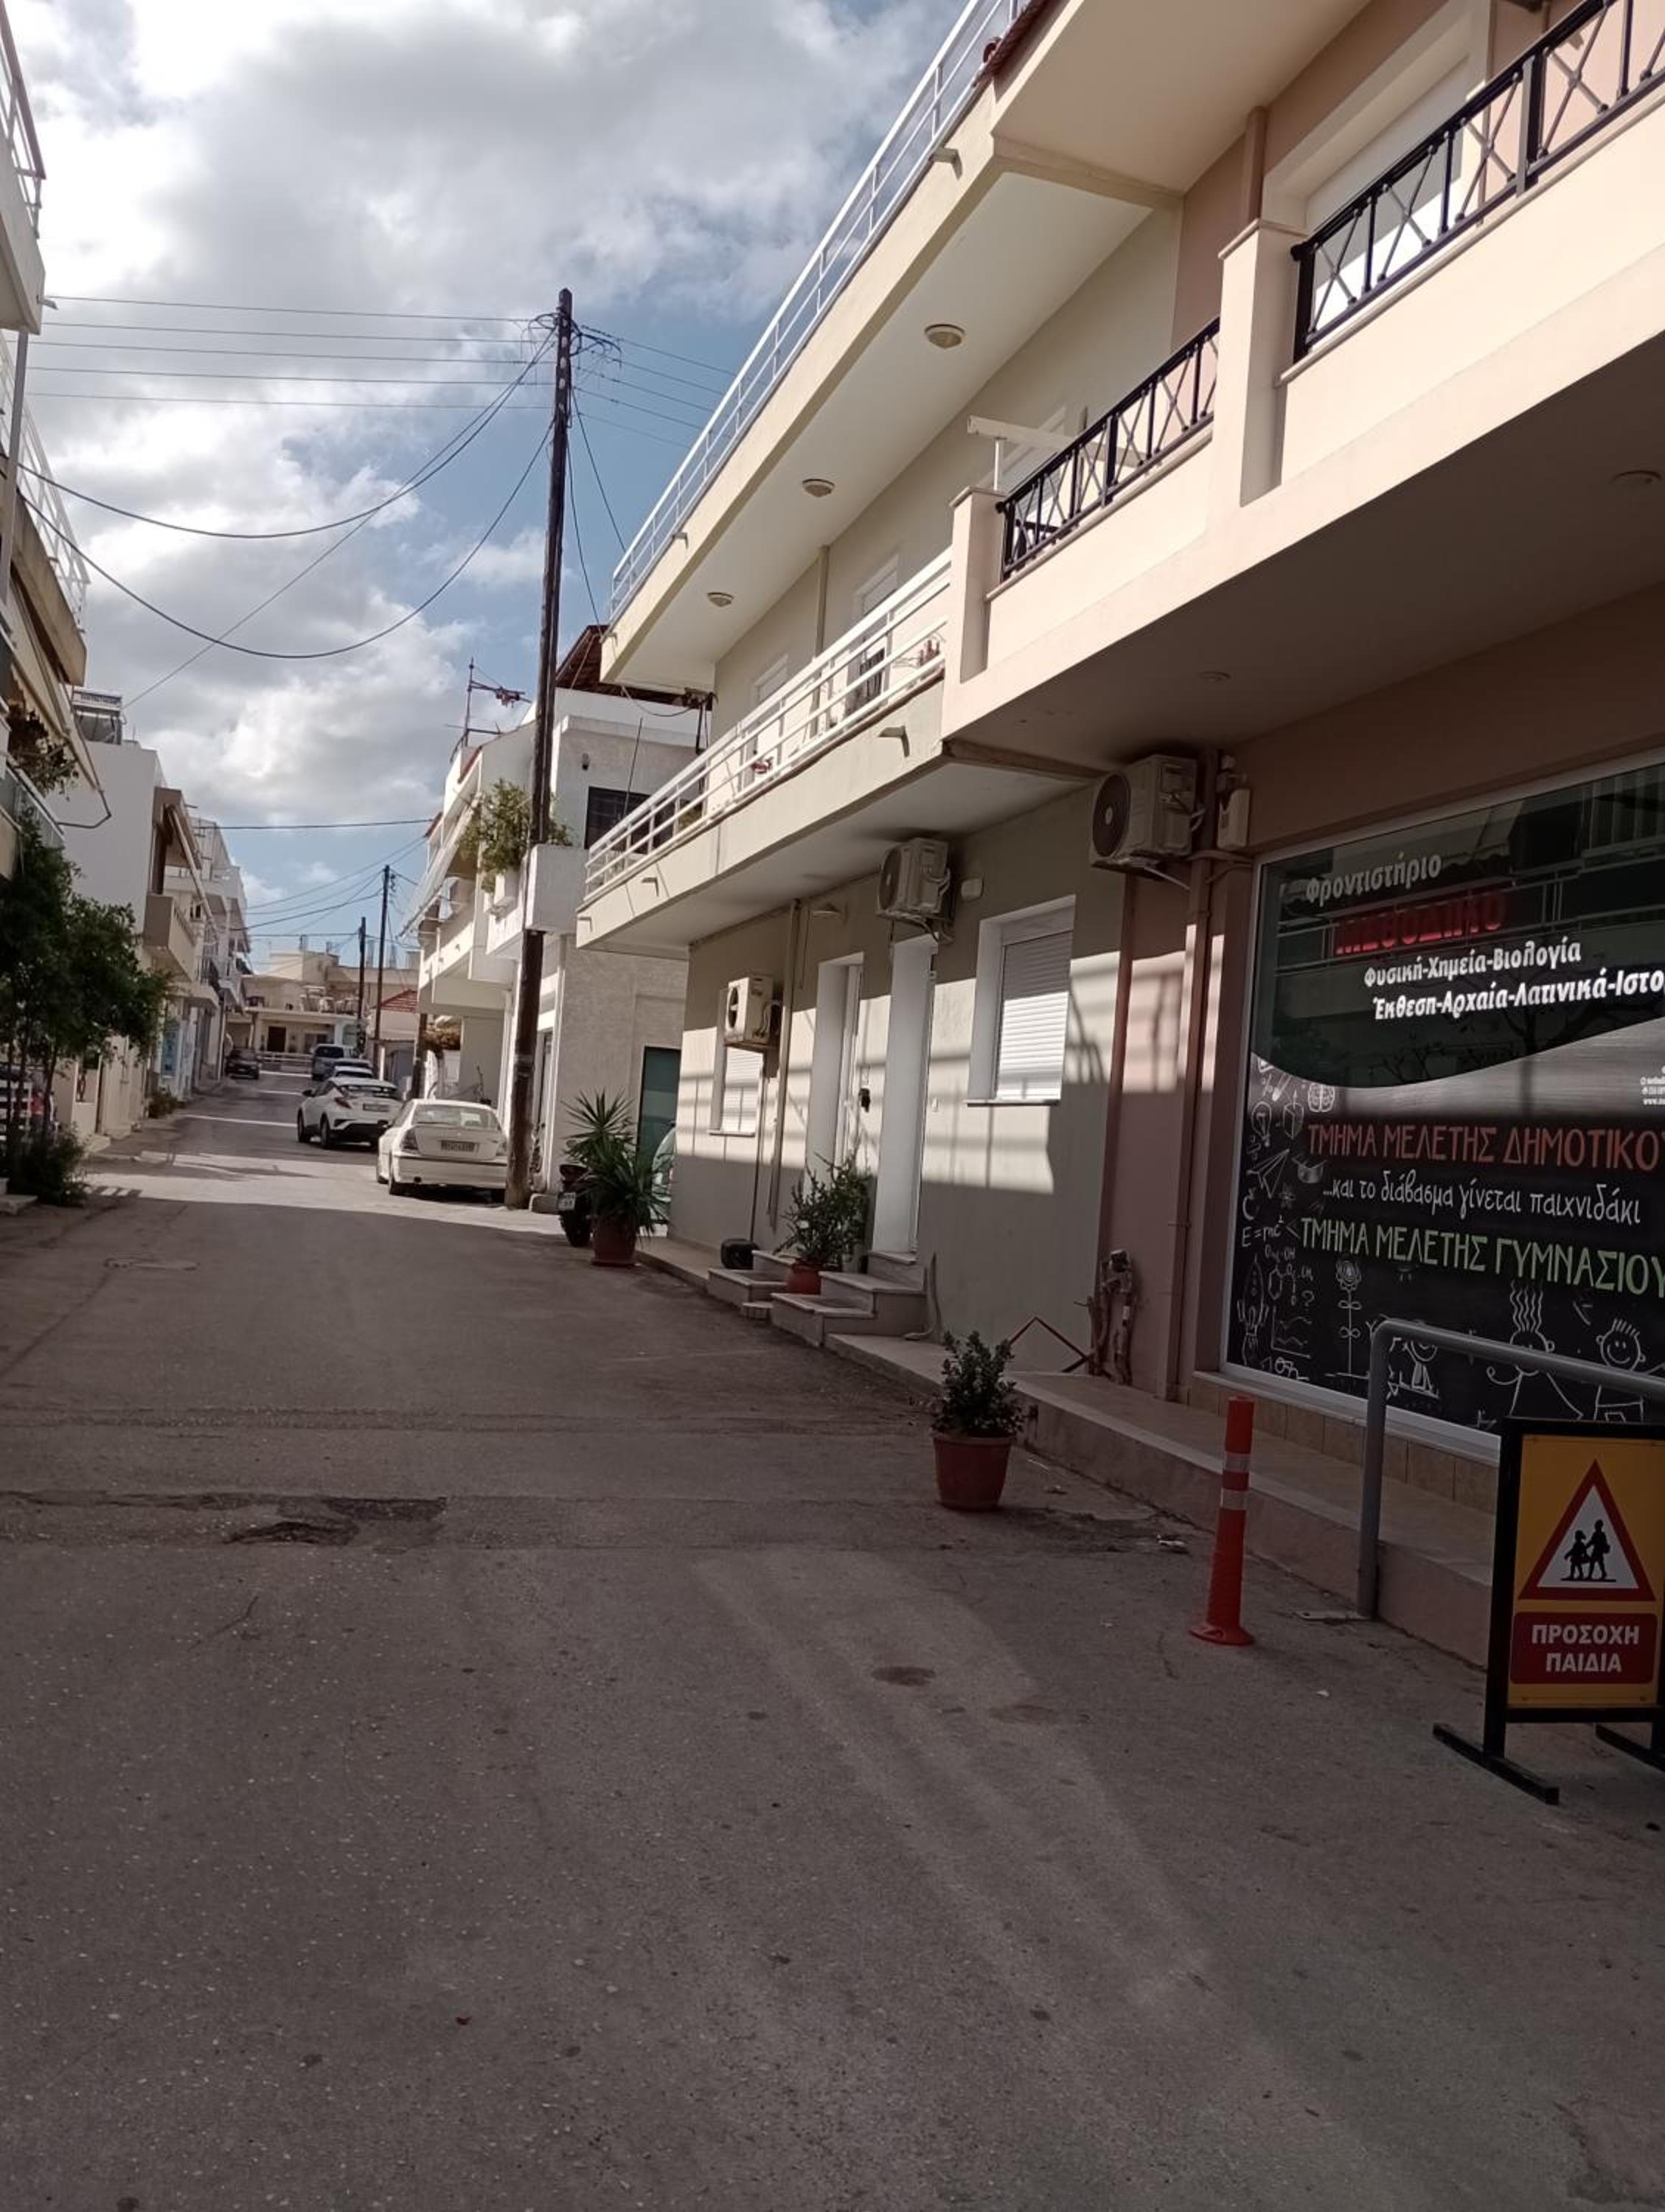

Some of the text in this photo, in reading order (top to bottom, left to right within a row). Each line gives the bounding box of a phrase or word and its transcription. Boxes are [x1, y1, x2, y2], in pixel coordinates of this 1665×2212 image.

[1305, 852, 1442, 905] Φροντιστήριο
[1373, 966, 1665, 1020] Έκθεση-Αρχαία-Λατινικά-Ιστο
[1308, 1124, 1665, 1171] ΤΜΗΜΑ ΜΕΛΕΤΗΣ ΔΗΜΟΤΙΚΟ
[1360, 1180, 1376, 1198] το
[1380, 1169, 1453, 1216] διάβασμα
[1459, 1178, 1520, 1220] γίνεται
[1530, 1184, 1641, 1224] παιχνιδάκι
[1301, 1217, 1665, 1298] ΤΜΗΜΑ ΜΕΛΕΤΗΣ ΓΥΜΝΑΣΙΟΥ
[1532, 1624, 1639, 1645] ΠΡΟΣΟΧΗ
[1546, 1652, 1621, 1672] ΠΑΙΔΙΑ
